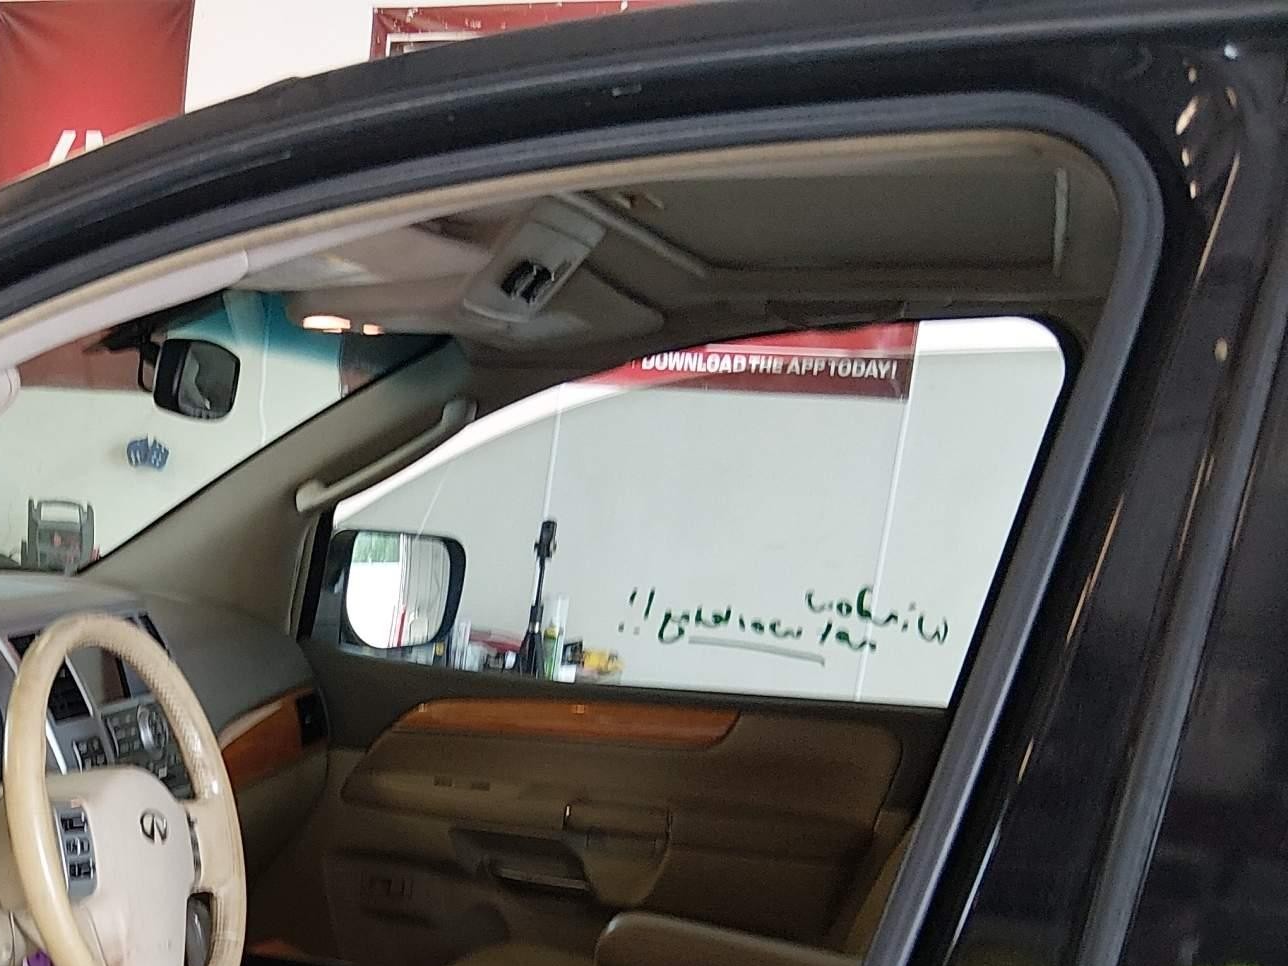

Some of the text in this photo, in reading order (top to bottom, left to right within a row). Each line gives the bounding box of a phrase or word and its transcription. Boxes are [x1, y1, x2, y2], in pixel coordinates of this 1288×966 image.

[641, 351, 899, 380] DOWNLOAD THE APP TODAY!
